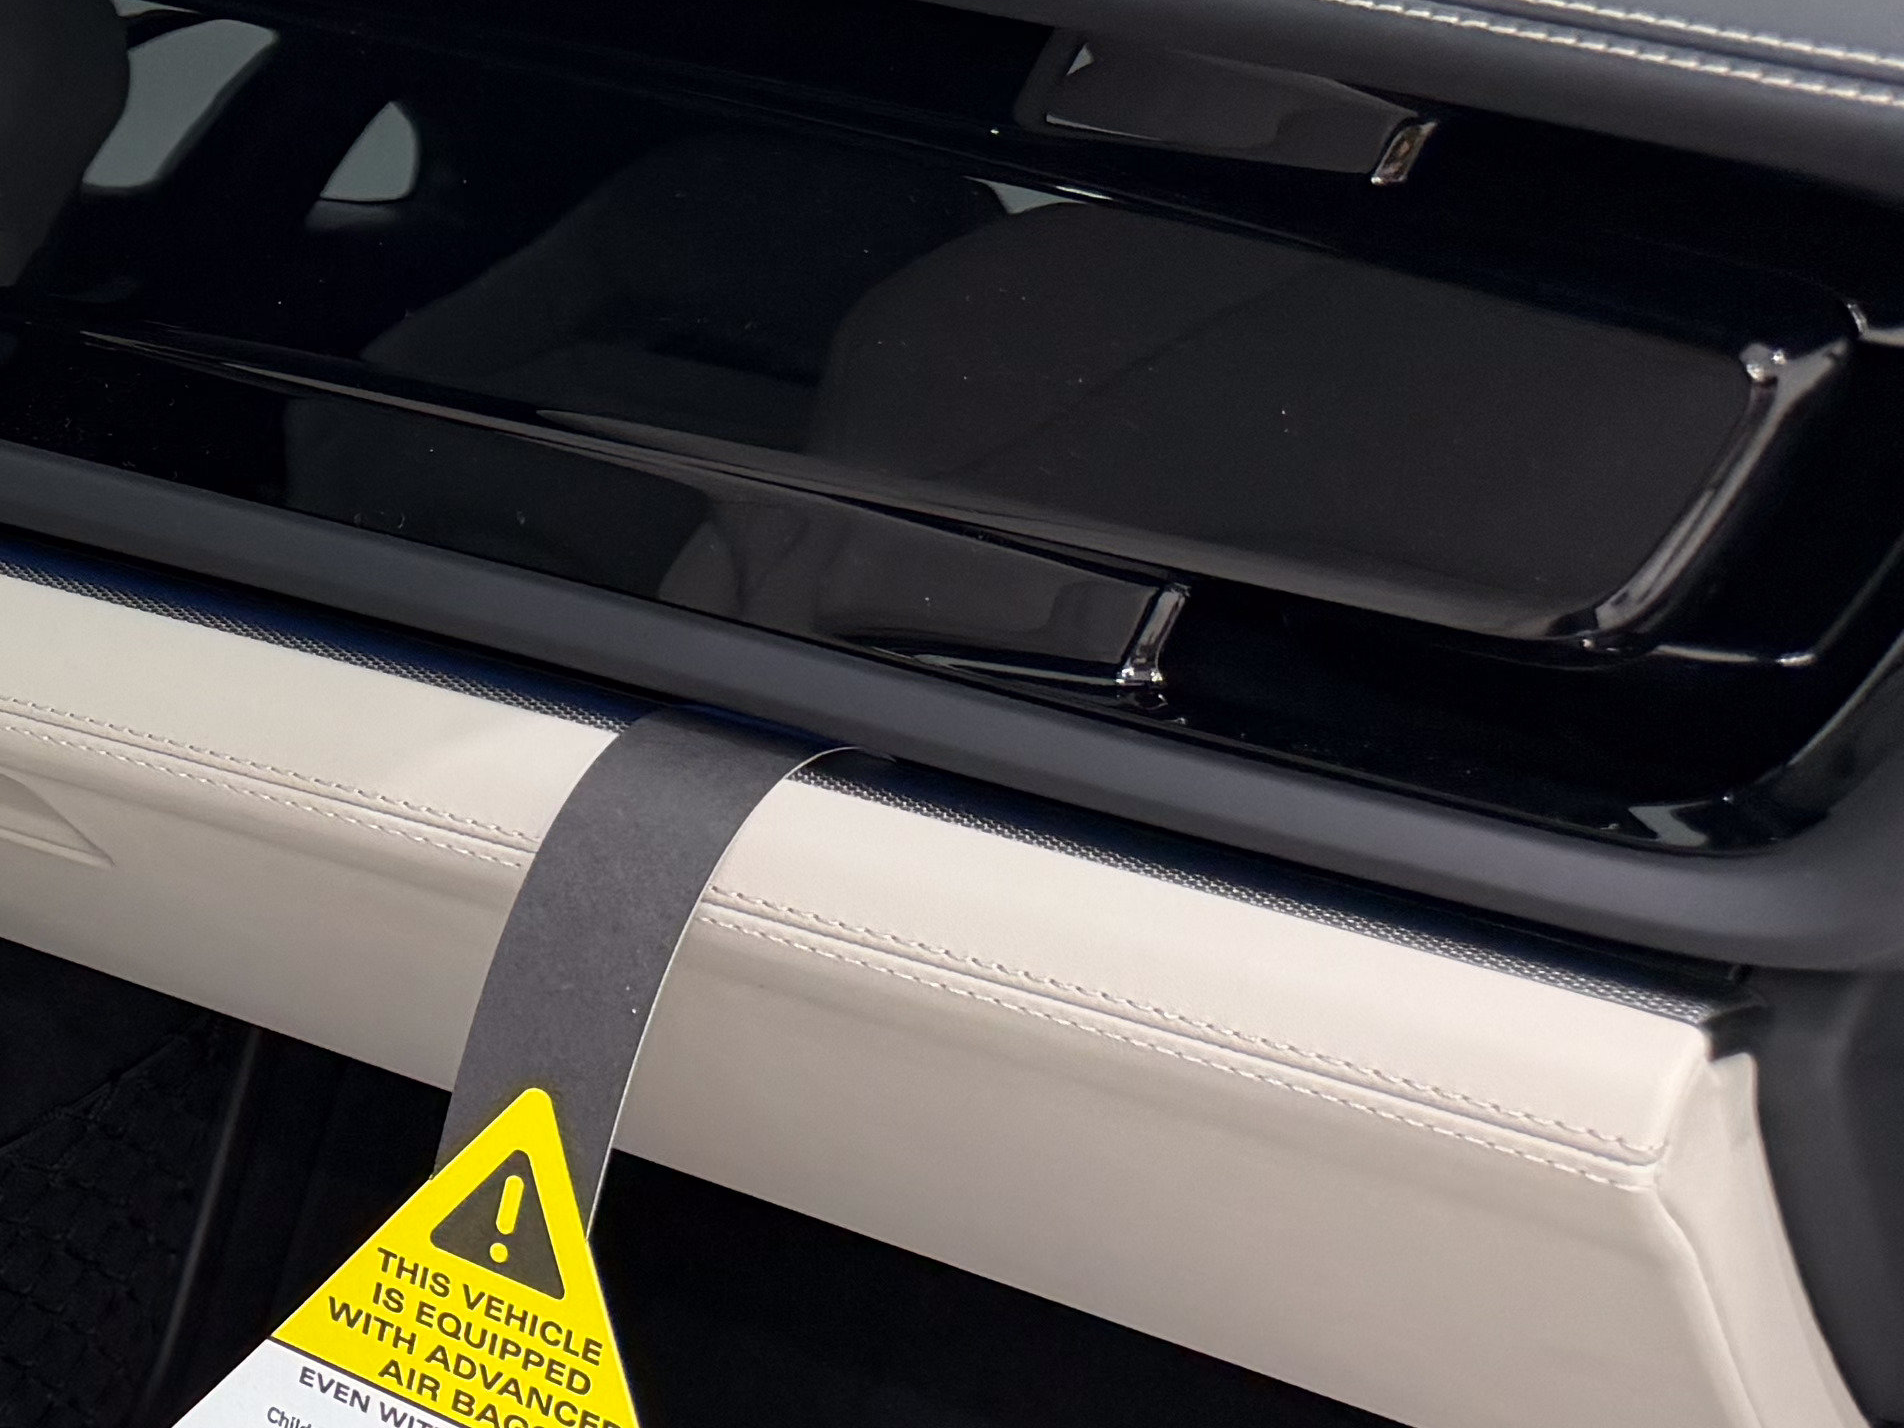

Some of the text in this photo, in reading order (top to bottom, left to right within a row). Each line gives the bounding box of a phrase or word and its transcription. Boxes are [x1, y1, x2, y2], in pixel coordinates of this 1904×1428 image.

[328, 1295, 418, 1356] WITH
[376, 1246, 604, 1367] THIS VEHICLE
[371, 1281, 592, 1396] IS EQUIPPED
[298, 1365, 372, 1414] EVEN
[377, 1358, 441, 1403] AIR
